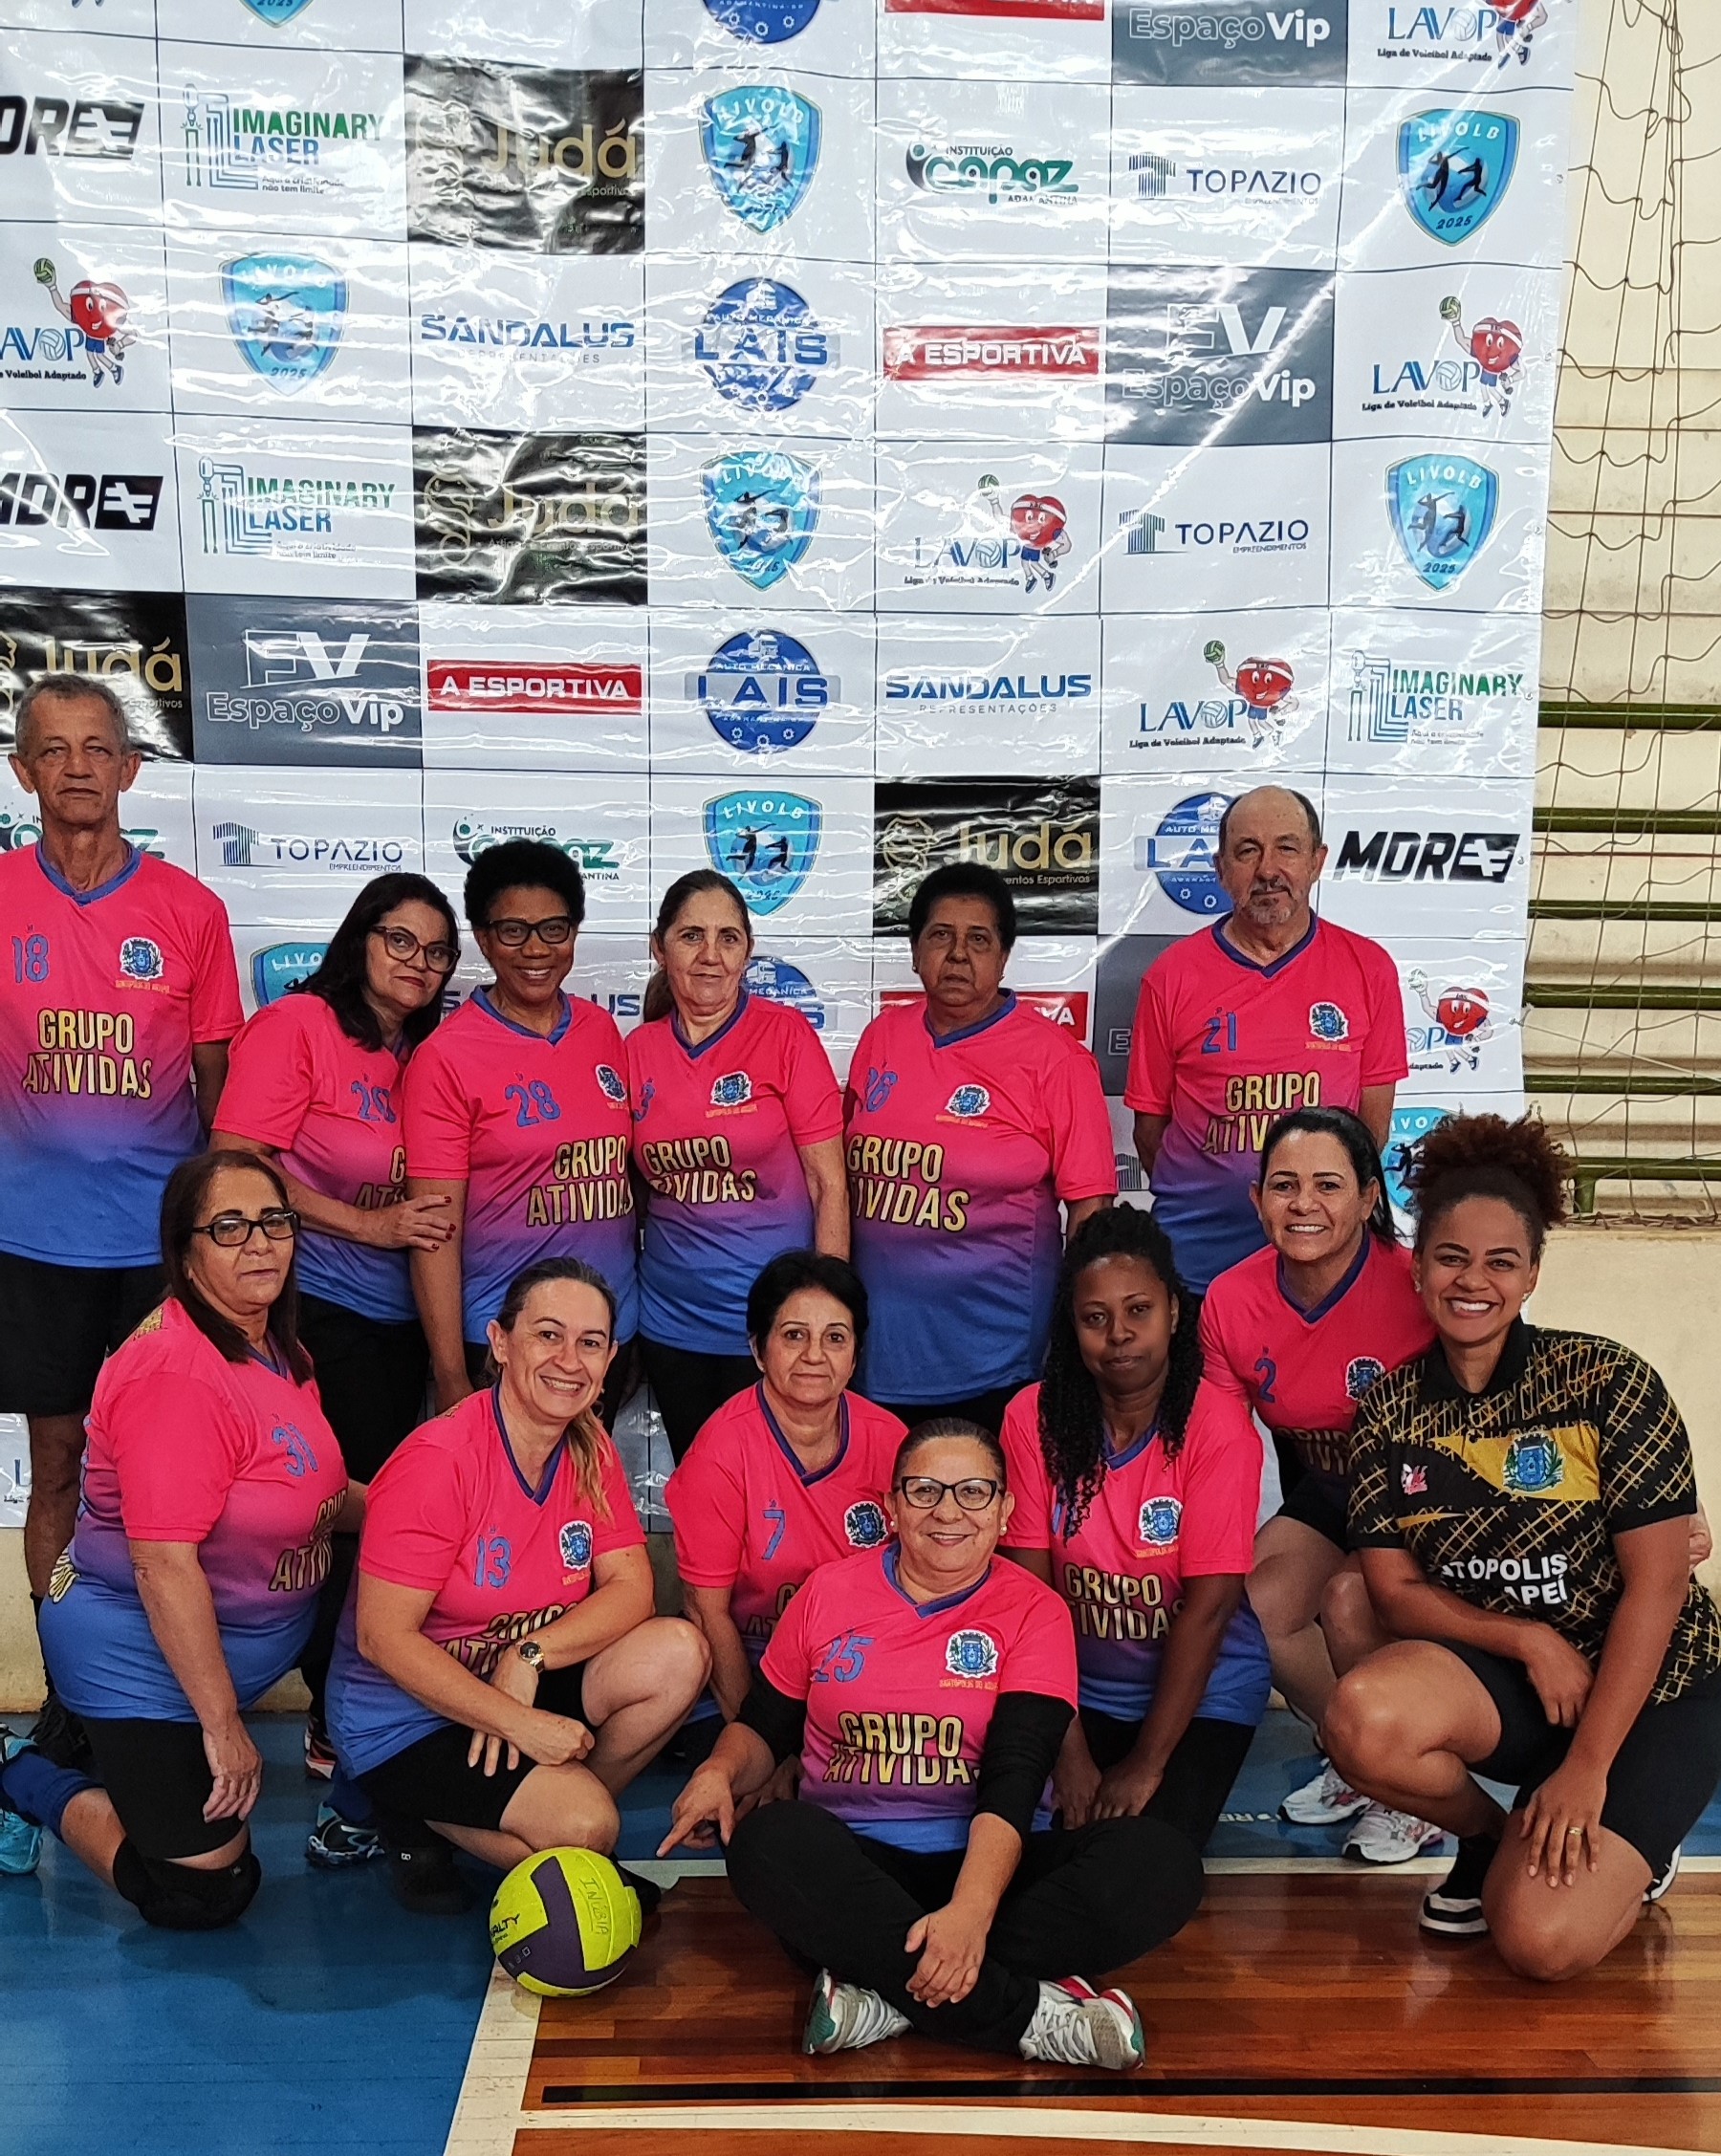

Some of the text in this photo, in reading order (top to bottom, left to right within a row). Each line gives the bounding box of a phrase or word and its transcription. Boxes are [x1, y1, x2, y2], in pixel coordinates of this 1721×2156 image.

[1377, 48, 1397, 58] Liga
[1399, 49, 1410, 57] de
[1412, 49, 1449, 59] Voleibol
[233, 108, 384, 142] IMAGINARY
[234, 136, 319, 165] LASER
[480, 119, 637, 179] Judá
[281, 185, 298, 193] tem
[1186, 168, 1321, 196] TOPAZIO
[1435, 215, 1473, 230] 2025
[0, 327, 85, 362] AVOP
[421, 314, 636, 349] SANDALUS
[694, 327, 828, 365] LAIS
[924, 342, 1087, 366] ESPORTIVA
[5, 369, 87, 381] Voleibol Adaptado
[1362, 403, 1383, 412] Liga
[1384, 401, 1396, 409] de
[1397, 400, 1435, 408] Voleibol
[247, 476, 396, 509] IMAGINARY
[1406, 465, 1483, 490] LIVOLB
[249, 509, 333, 534] LASER
[487, 477, 639, 534] Judá
[1175, 519, 1309, 546] TOPAZIO
[1422, 561, 1456, 575] 2025
[439, 675, 630, 701] A ESPORTIVA
[885, 673, 1093, 700] SANDALUS
[1391, 668, 1524, 698] IMAGINARY
[1391, 695, 1464, 722] LASER
[1129, 735, 1247, 749] Liga de Voleibol Adaptado
[490, 824, 557, 838] INSTITUIÇÃO
[1165, 824, 1197, 834] AUTO
[271, 837, 404, 864] TOPAZIO
[1147, 838, 1216, 868] LA
[1036, 874, 1091, 886] Esportivos
[12, 933, 50, 984] 18
[271, 950, 323, 971] LIVO
[37, 1008, 135, 1055] GRUPO
[1201, 1011, 1238, 1054] 21
[21, 1053, 153, 1100] ATIVIDAS
[1225, 1070, 1322, 1112] GRUPO
[504, 1078, 562, 1127] 28
[1201, 1113, 1277, 1154] ATIV
[554, 1135, 627, 1181] GRUPO
[642, 1135, 731, 1177] GRUPO
[845, 1134, 945, 1184] GRUPO
[1253, 1357, 1277, 1405] 2
[761, 1508, 787, 1560] 7
[473, 1535, 512, 1590] 13
[1064, 1563, 1164, 1608] GRUPO
[480, 1602, 580, 1641] GRUP
[815, 1634, 876, 1684] 25
[838, 1710, 964, 1758] GRUPO
[822, 1742, 982, 1785] ATIVIDA
